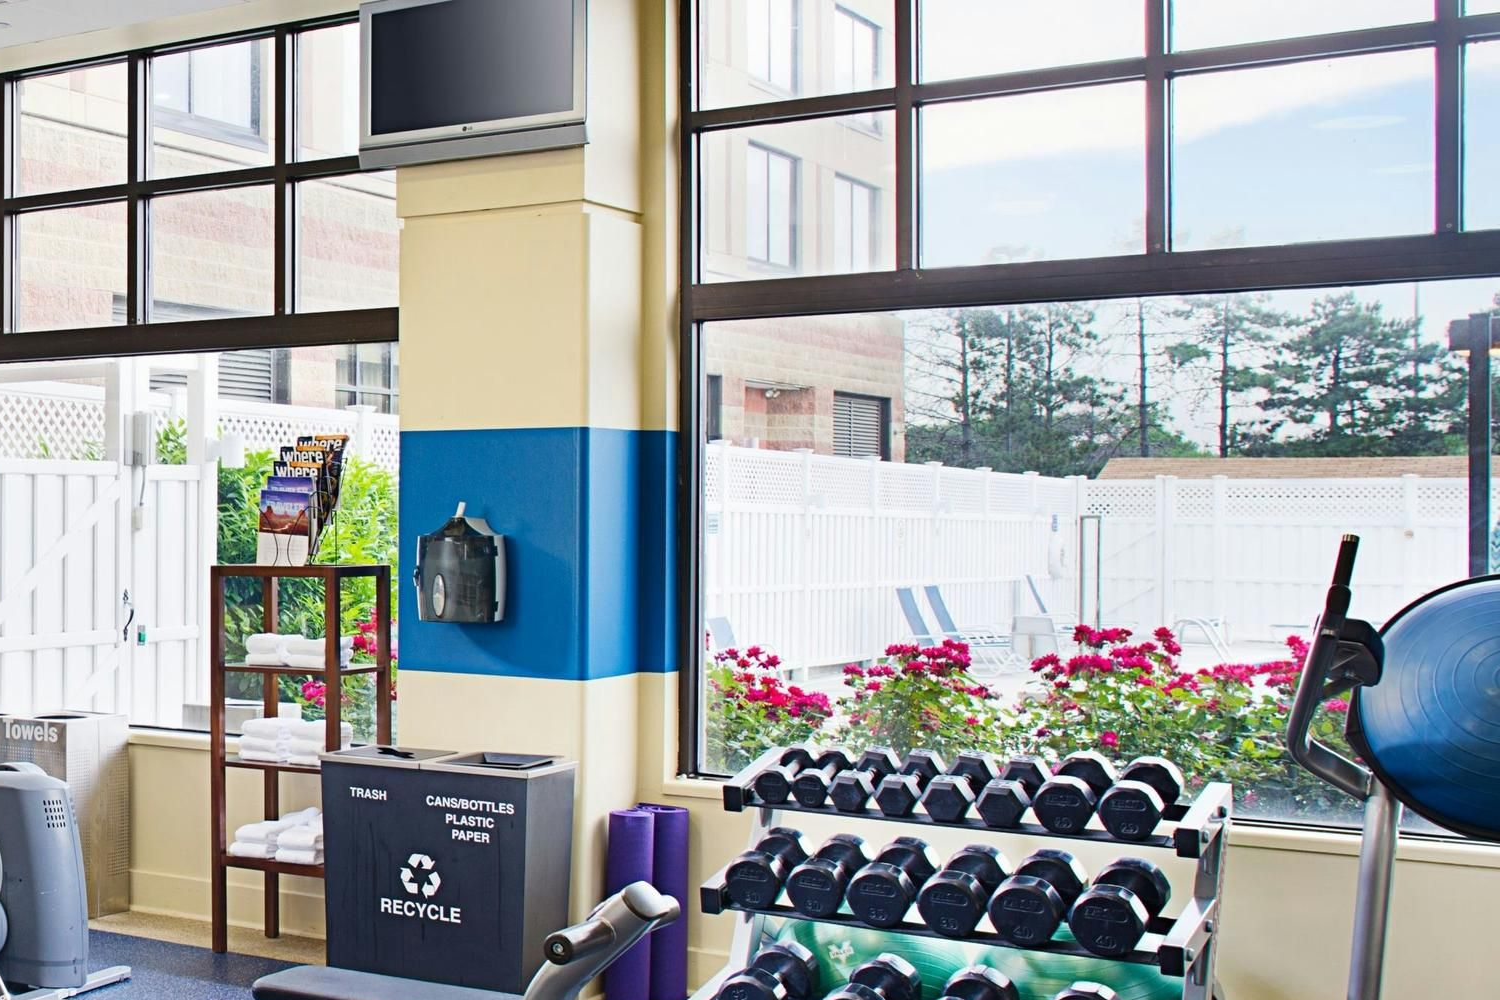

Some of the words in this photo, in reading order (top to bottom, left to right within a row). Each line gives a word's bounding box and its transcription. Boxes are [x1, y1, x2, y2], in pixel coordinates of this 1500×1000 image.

[282, 446, 324, 463] where
[275, 462, 318, 478] where
[2, 717, 59, 743] Towels
[349, 786, 388, 801] TRASH
[426, 795, 515, 815] CANS/BOTTLES
[445, 813, 495, 829] PLASTIC
[451, 829, 490, 844] PAPER
[380, 898, 462, 924] RECYCLE
